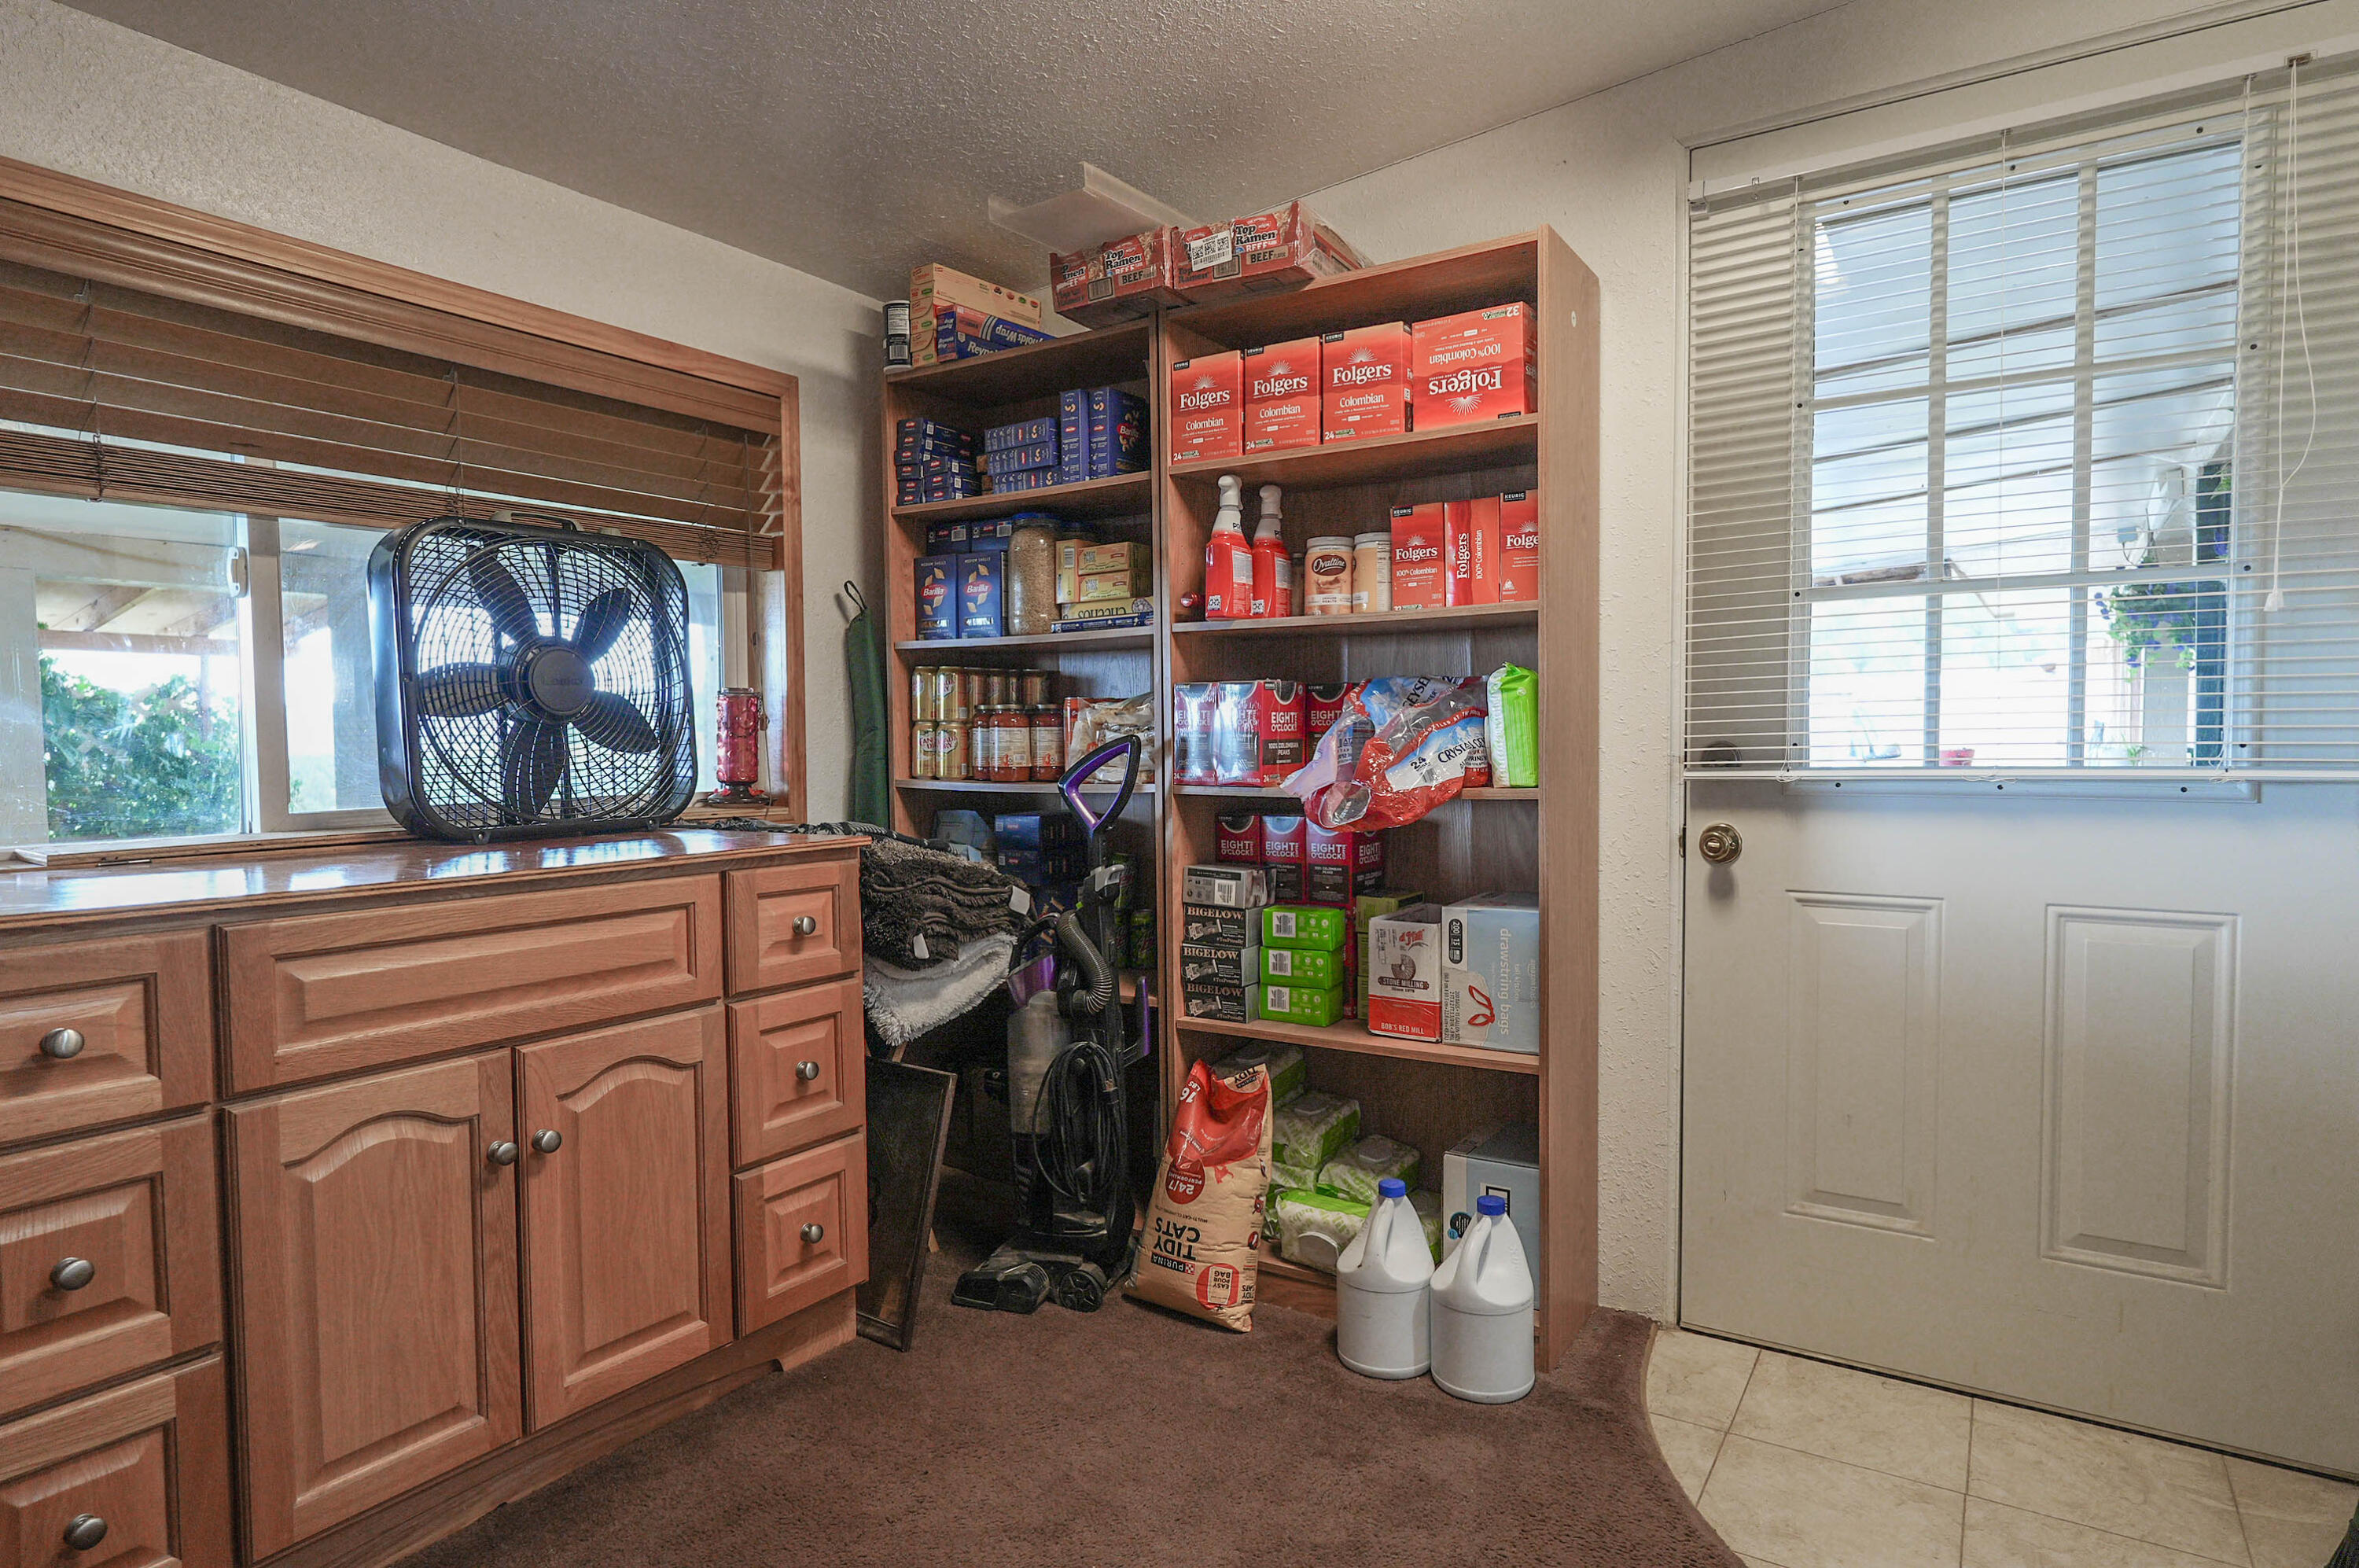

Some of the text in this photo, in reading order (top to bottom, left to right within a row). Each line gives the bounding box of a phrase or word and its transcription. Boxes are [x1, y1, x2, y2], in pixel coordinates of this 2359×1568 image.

[1235, 225, 1256, 235] Top
[1235, 230, 1276, 246] Ramen
[1105, 249, 1124, 260] Top
[1250, 250, 1274, 263] BEEF
[1105, 253, 1143, 270] Ramen
[1122, 271, 1143, 284] BEEF
[1507, 305, 1520, 318] 32
[995, 324, 1018, 343] Wrap
[1430, 344, 1501, 365] 100% Colombian
[1332, 364, 1393, 385] Folgers
[1253, 376, 1308, 396] Folgers
[1428, 370, 1503, 396] Folgers
[1180, 389, 1231, 410] Folgers
[1339, 392, 1384, 408] Colombian
[1260, 403, 1301, 418] Colombian
[1186, 417, 1224, 431] Colombian
[1325, 431, 1334, 440] 24
[1246, 440, 1256, 450] 24
[1173, 452, 1183, 461] 24
[1506, 534, 1539, 549] Folge
[1395, 547, 1438, 561] Folgers
[1456, 532, 1470, 579] Folgers
[1313, 557, 1345, 572] Ovaltine
[1410, 566, 1437, 576] Colombian
[923, 587, 944, 597] Barilla
[966, 583, 988, 594] Barilla
[1272, 712, 1295, 723] EIGHT
[1311, 710, 1341, 720] EIGHT
[1272, 723, 1294, 732] O'CLOCK
[1437, 741, 1476, 763] CRYSTAL
[1410, 756, 1426, 770] 24
[1221, 840, 1250, 849] EIGHT
[1265, 841, 1295, 851] EIGHT
[1311, 843, 1343, 852] EIGHT
[1359, 843, 1379, 856] EIGHT
[1187, 906, 1243, 919] BIGELOW
[1452, 921, 1461, 934] 200
[1183, 947, 1239, 959] BIGELOW
[1400, 980, 1425, 989] MILLING
[1498, 928, 1512, 1035] drawstring bags
[1187, 983, 1243, 996] BIGELOW
[1381, 1022, 1398, 1031] BOB'S
[1411, 1025, 1425, 1034] MILL
[1188, 1081, 1201, 1091] LBS
[1180, 1088, 1197, 1102] 16
[1168, 1180, 1194, 1194] 24/7
[1155, 1216, 1201, 1242] CATS
[1154, 1236, 1197, 1261] TIDY
[1153, 1254, 1184, 1272] PURINA
